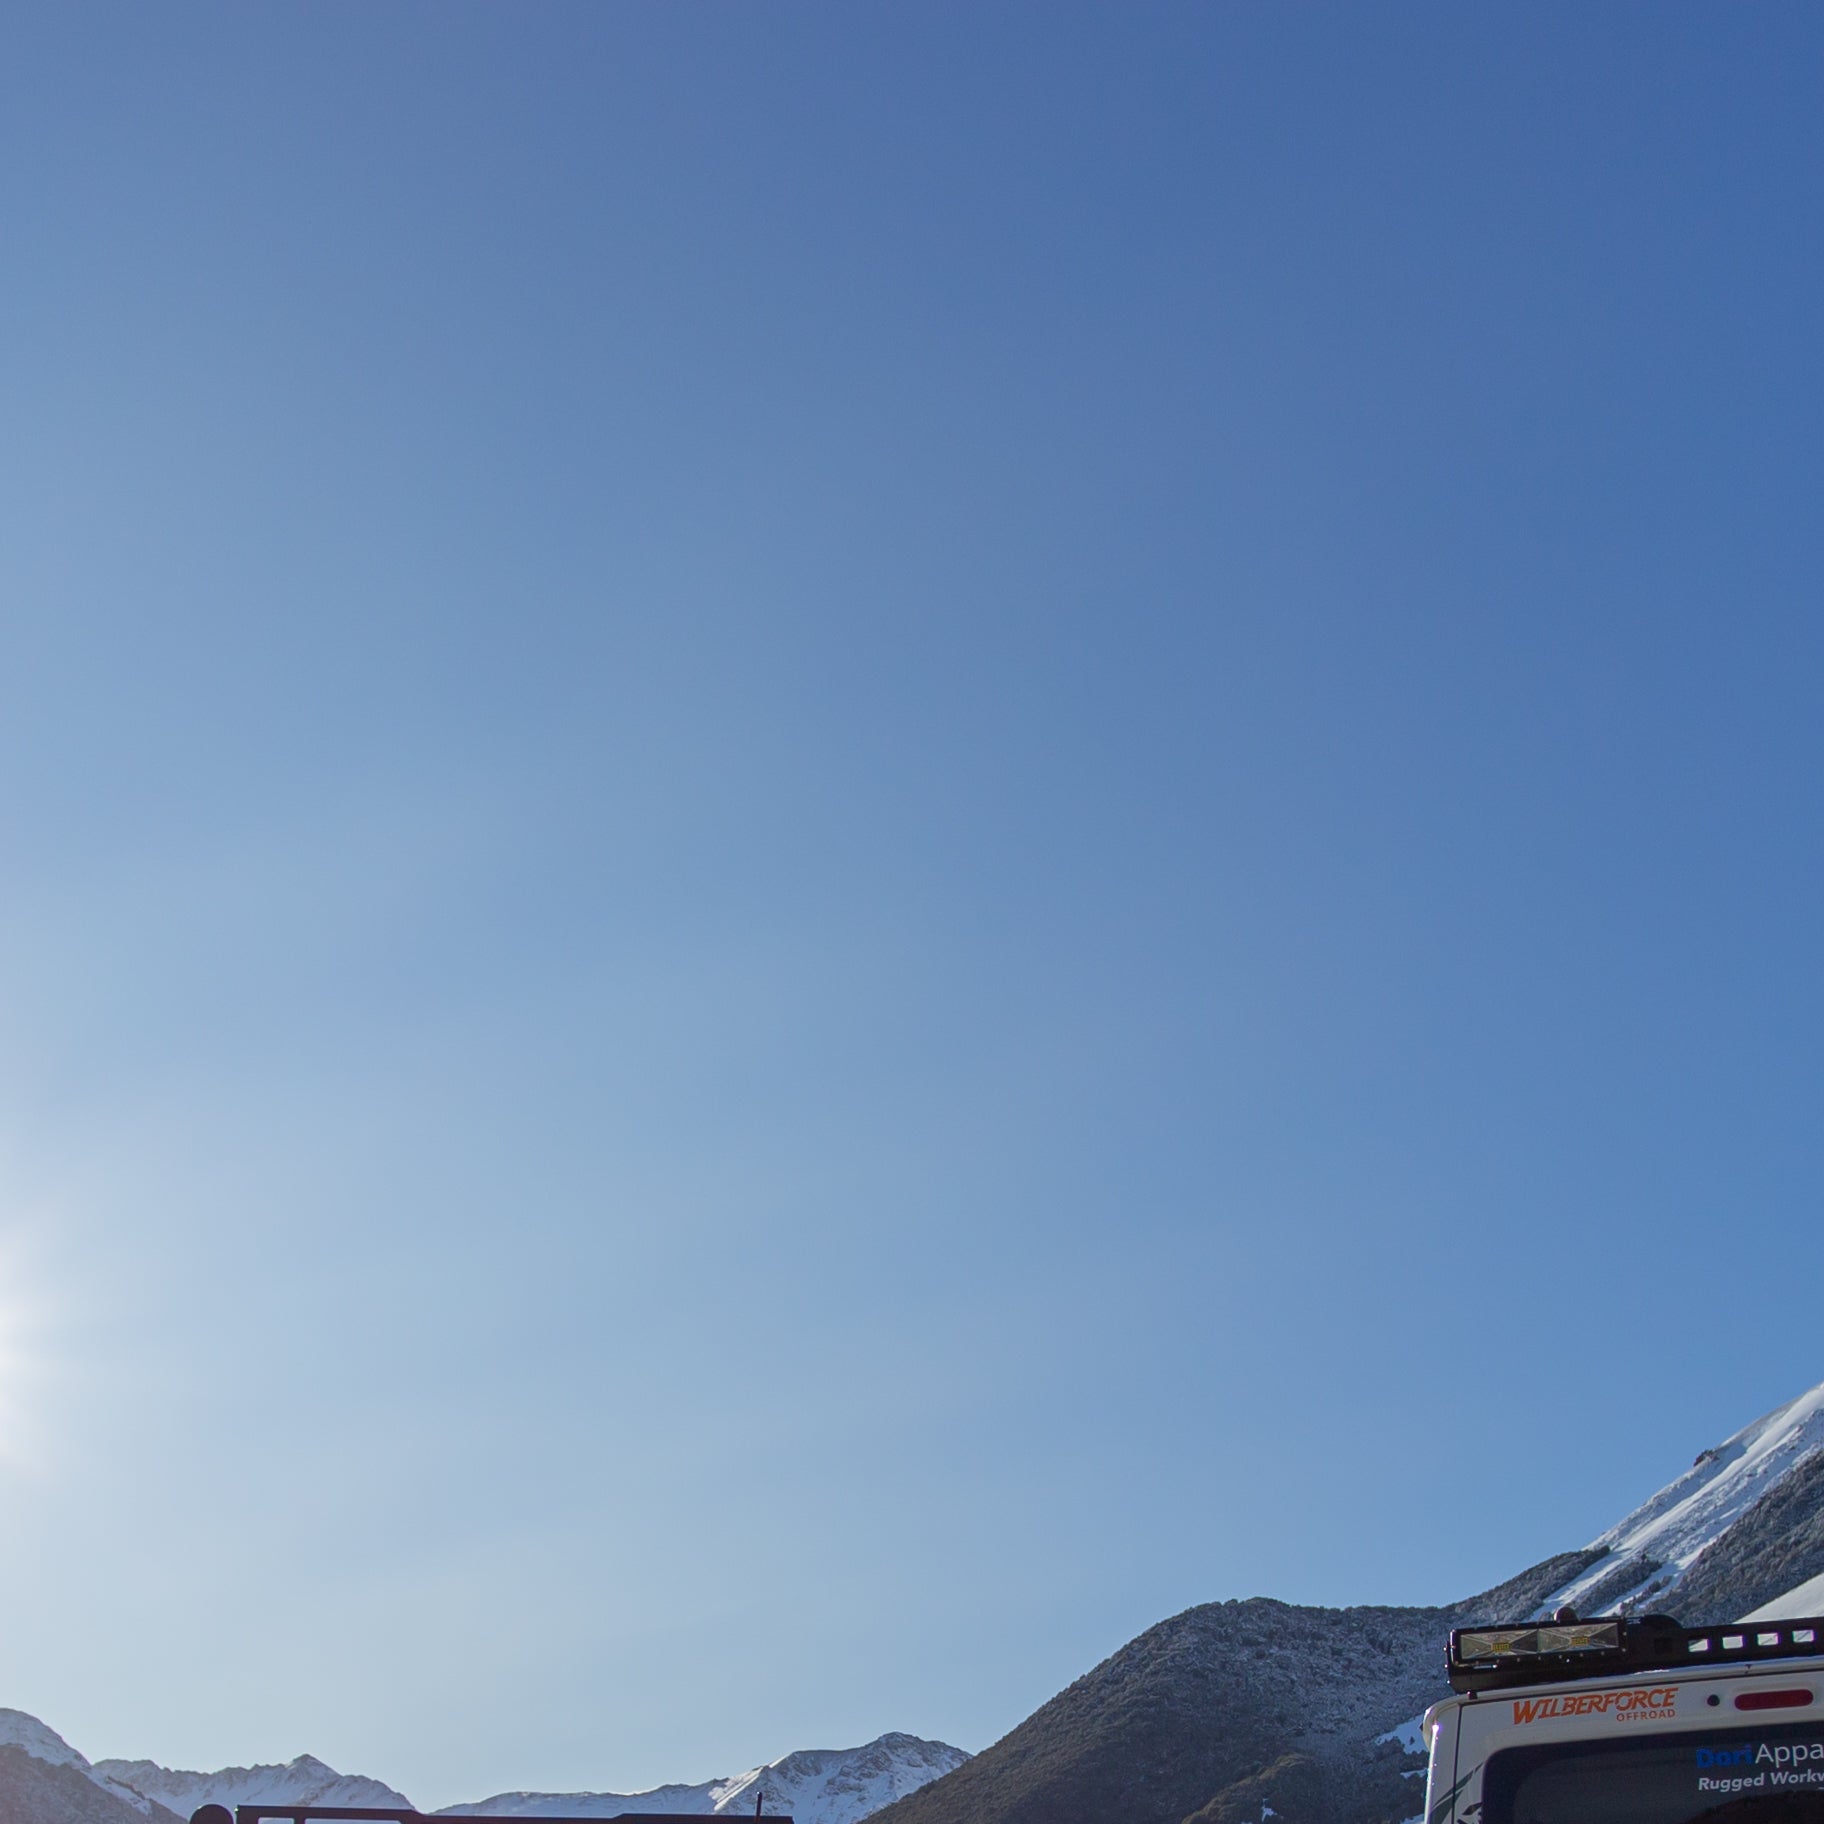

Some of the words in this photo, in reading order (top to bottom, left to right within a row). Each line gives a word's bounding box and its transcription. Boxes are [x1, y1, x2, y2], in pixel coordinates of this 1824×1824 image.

[1513, 1687, 1679, 1725] WILBERFORCE
[1616, 1708, 1676, 1722] OFFROAD
[1698, 1772, 1765, 1793] Rugged
